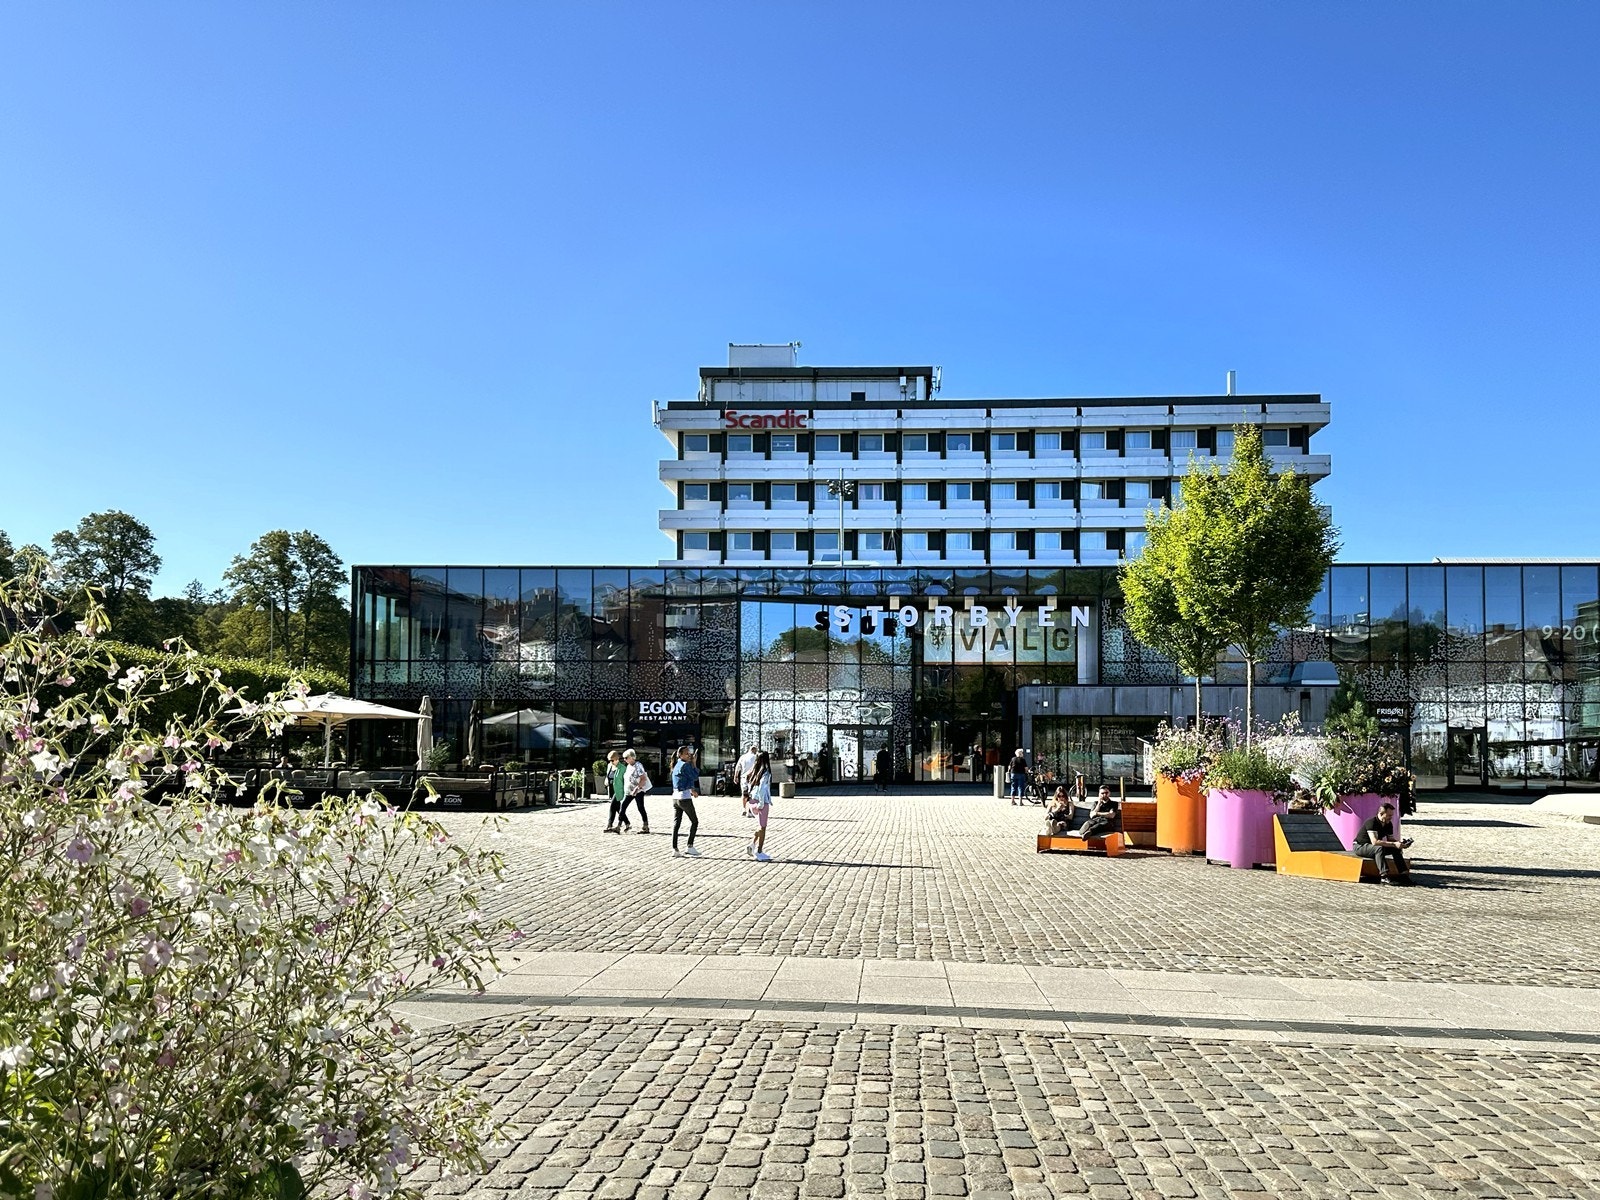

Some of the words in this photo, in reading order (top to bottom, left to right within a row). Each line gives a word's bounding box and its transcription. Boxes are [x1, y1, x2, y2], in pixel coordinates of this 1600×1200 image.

[725, 409, 807, 428] Scandic
[833, 605, 1090, 627] STORBYEN
[960, 628, 1070, 651] VALG
[1542, 625, 1586, 640] 9-20
[639, 701, 688, 714] EGON
